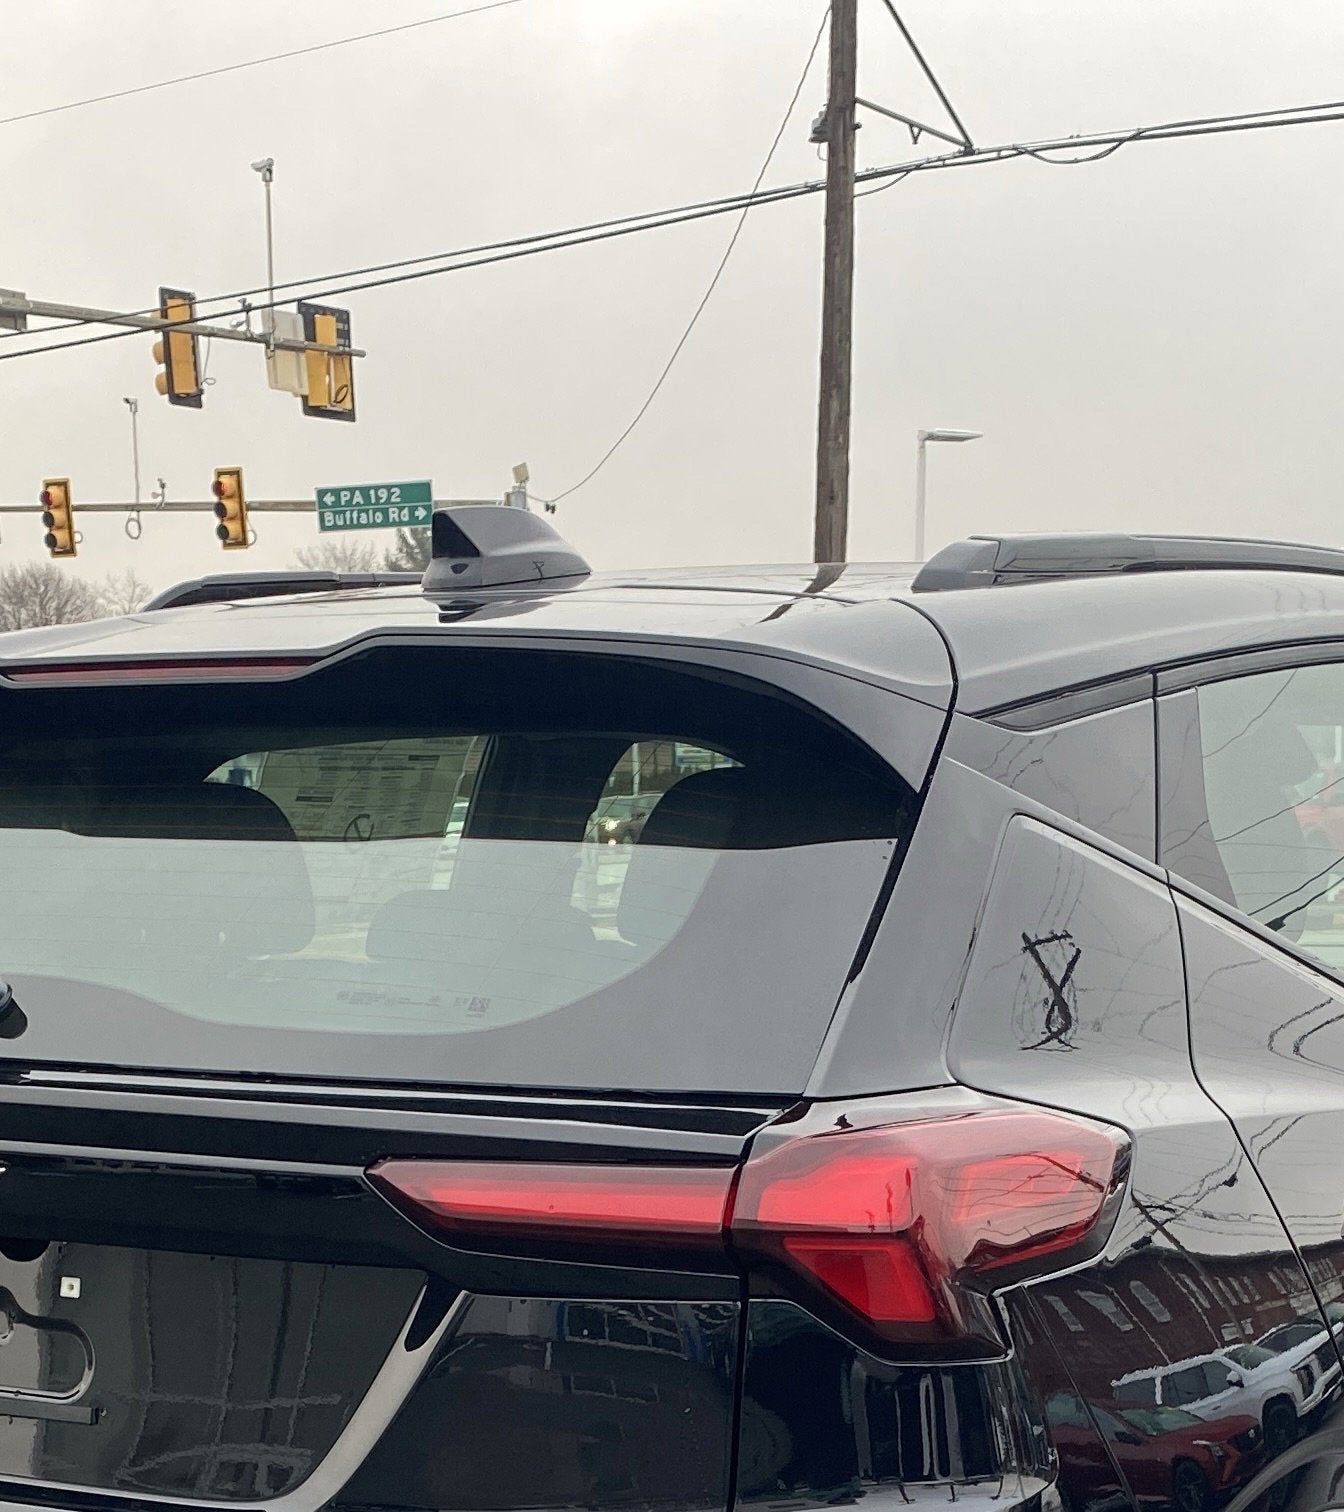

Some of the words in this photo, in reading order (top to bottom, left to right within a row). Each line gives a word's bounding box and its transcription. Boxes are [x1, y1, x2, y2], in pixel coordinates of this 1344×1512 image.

[340, 490, 364, 505] PA
[369, 487, 401, 503] 192
[324, 508, 383, 526] Buffalo
[388, 506, 410, 522] Rd
